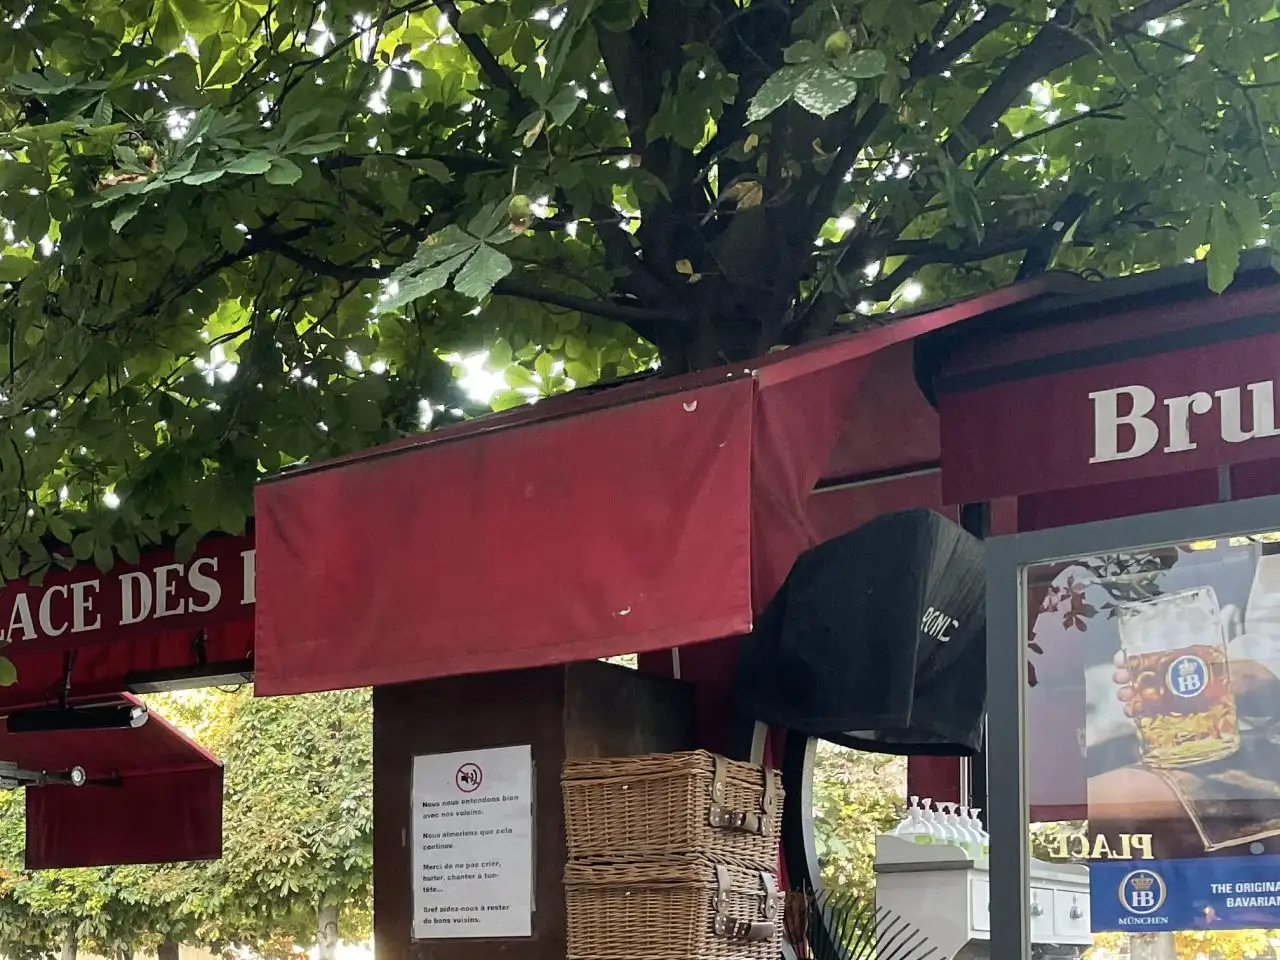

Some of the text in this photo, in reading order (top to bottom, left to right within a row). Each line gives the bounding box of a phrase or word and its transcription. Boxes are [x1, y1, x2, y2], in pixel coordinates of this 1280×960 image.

[1088, 380, 1280, 464] Bru
[119, 557, 221, 626] DES
[423, 863, 443, 871] Merci
[466, 861, 479, 869] pas
[481, 860, 502, 868] crier,
[447, 872, 475, 881] chanter
[1211, 883, 1232, 894] THE
[1132, 891, 1155, 907] HB
[487, 903, 511, 911] rester
[423, 917, 432, 925] de
[1118, 916, 1169, 925] MÜNCHEN
